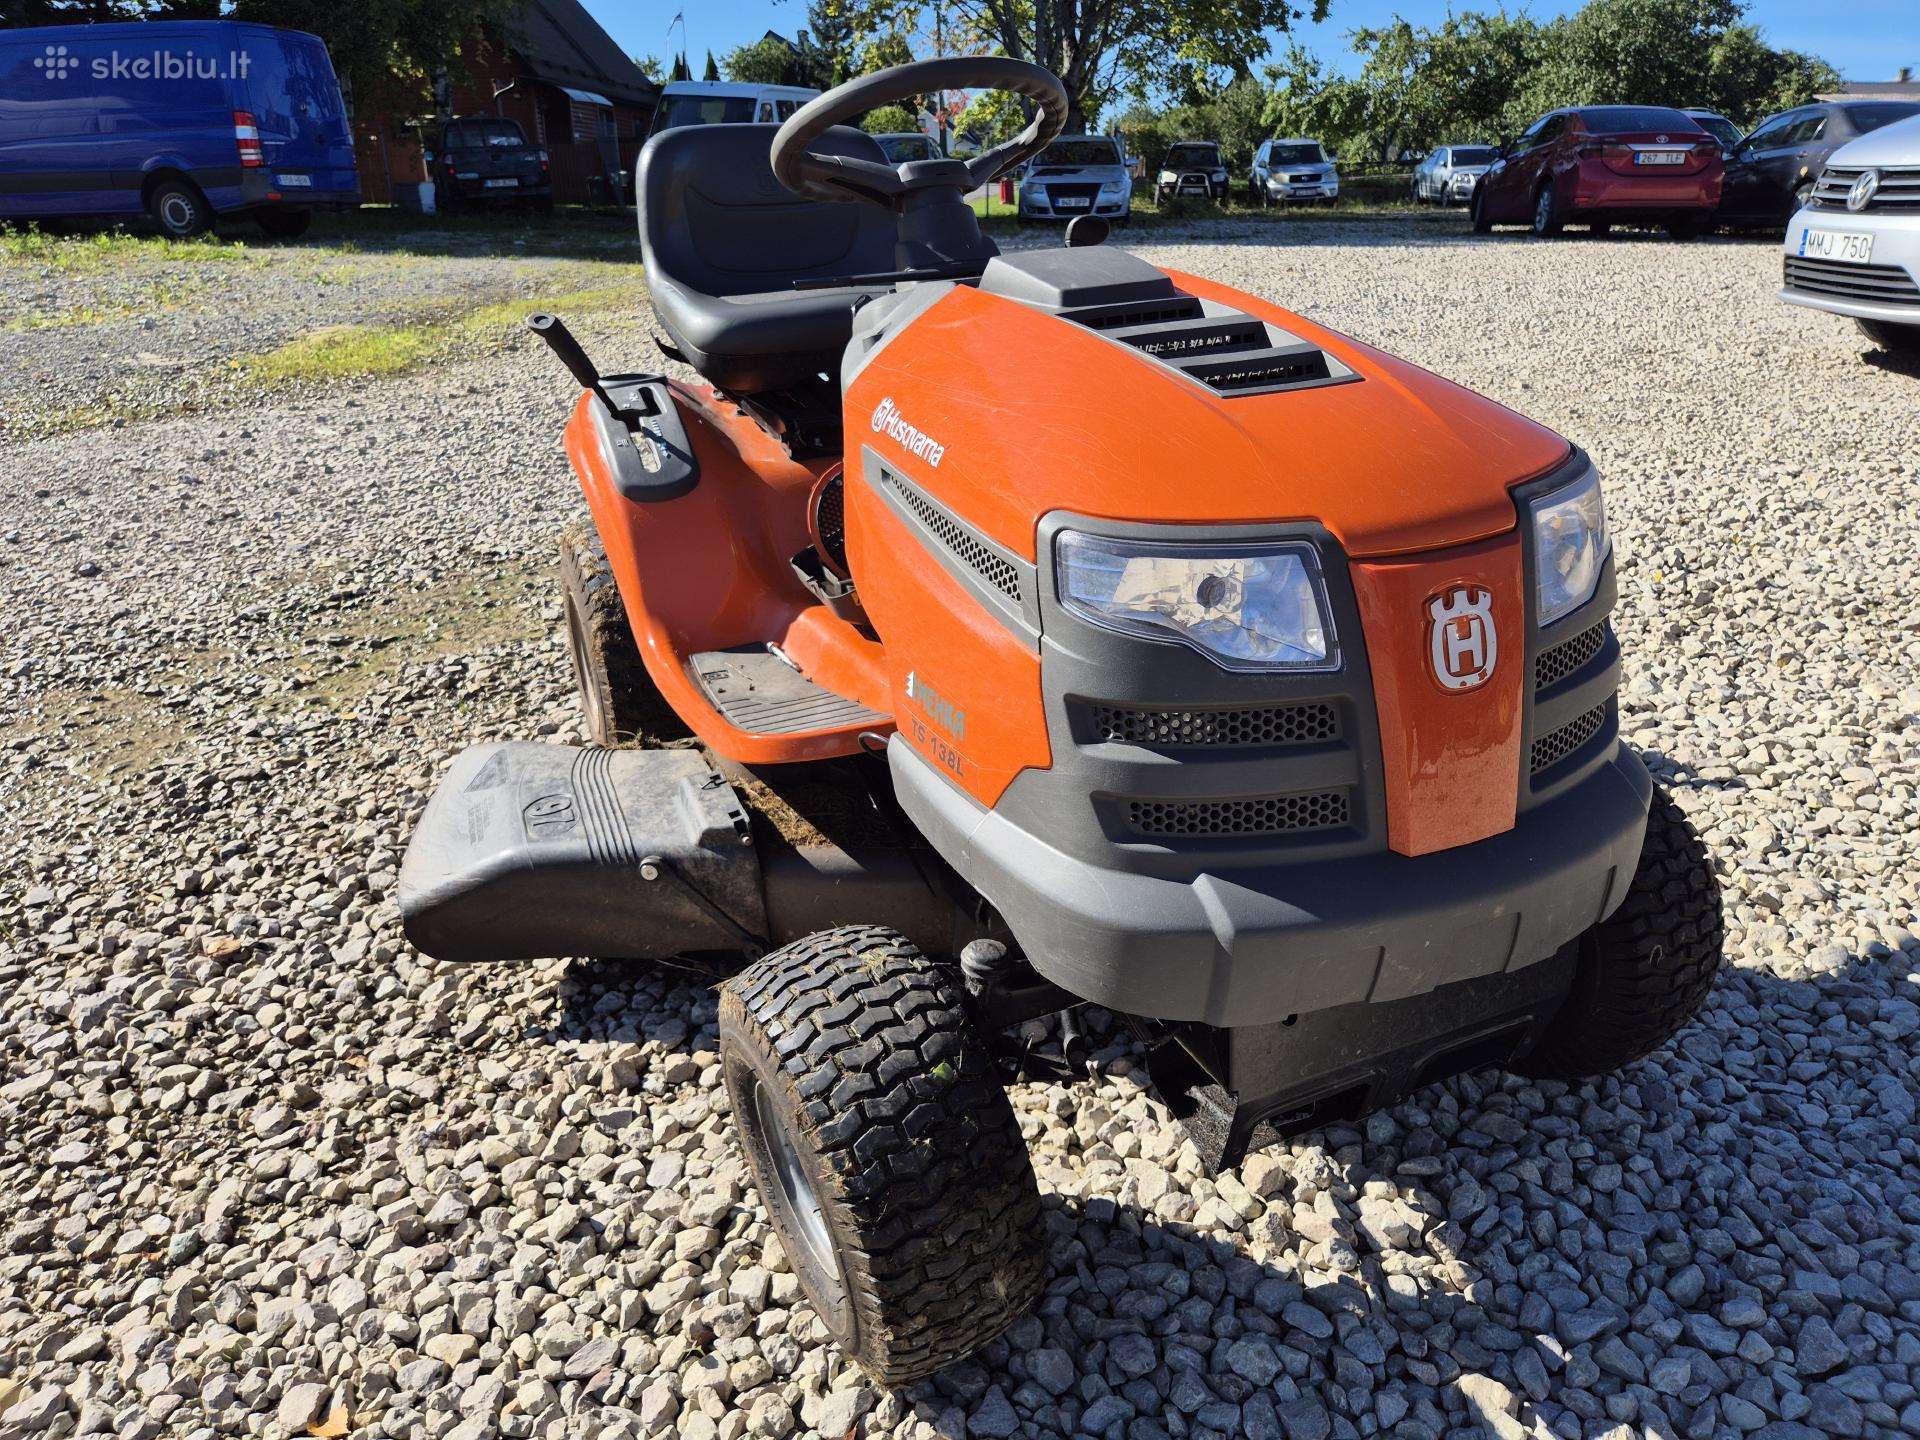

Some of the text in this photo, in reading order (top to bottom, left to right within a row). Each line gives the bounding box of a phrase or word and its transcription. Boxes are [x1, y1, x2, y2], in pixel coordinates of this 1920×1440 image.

[1641, 153, 1657, 163] 267
[1808, 233, 1869, 258] MMJ 750
[881, 406, 945, 468] Husqvarna
[911, 717, 964, 777] TS 138L
